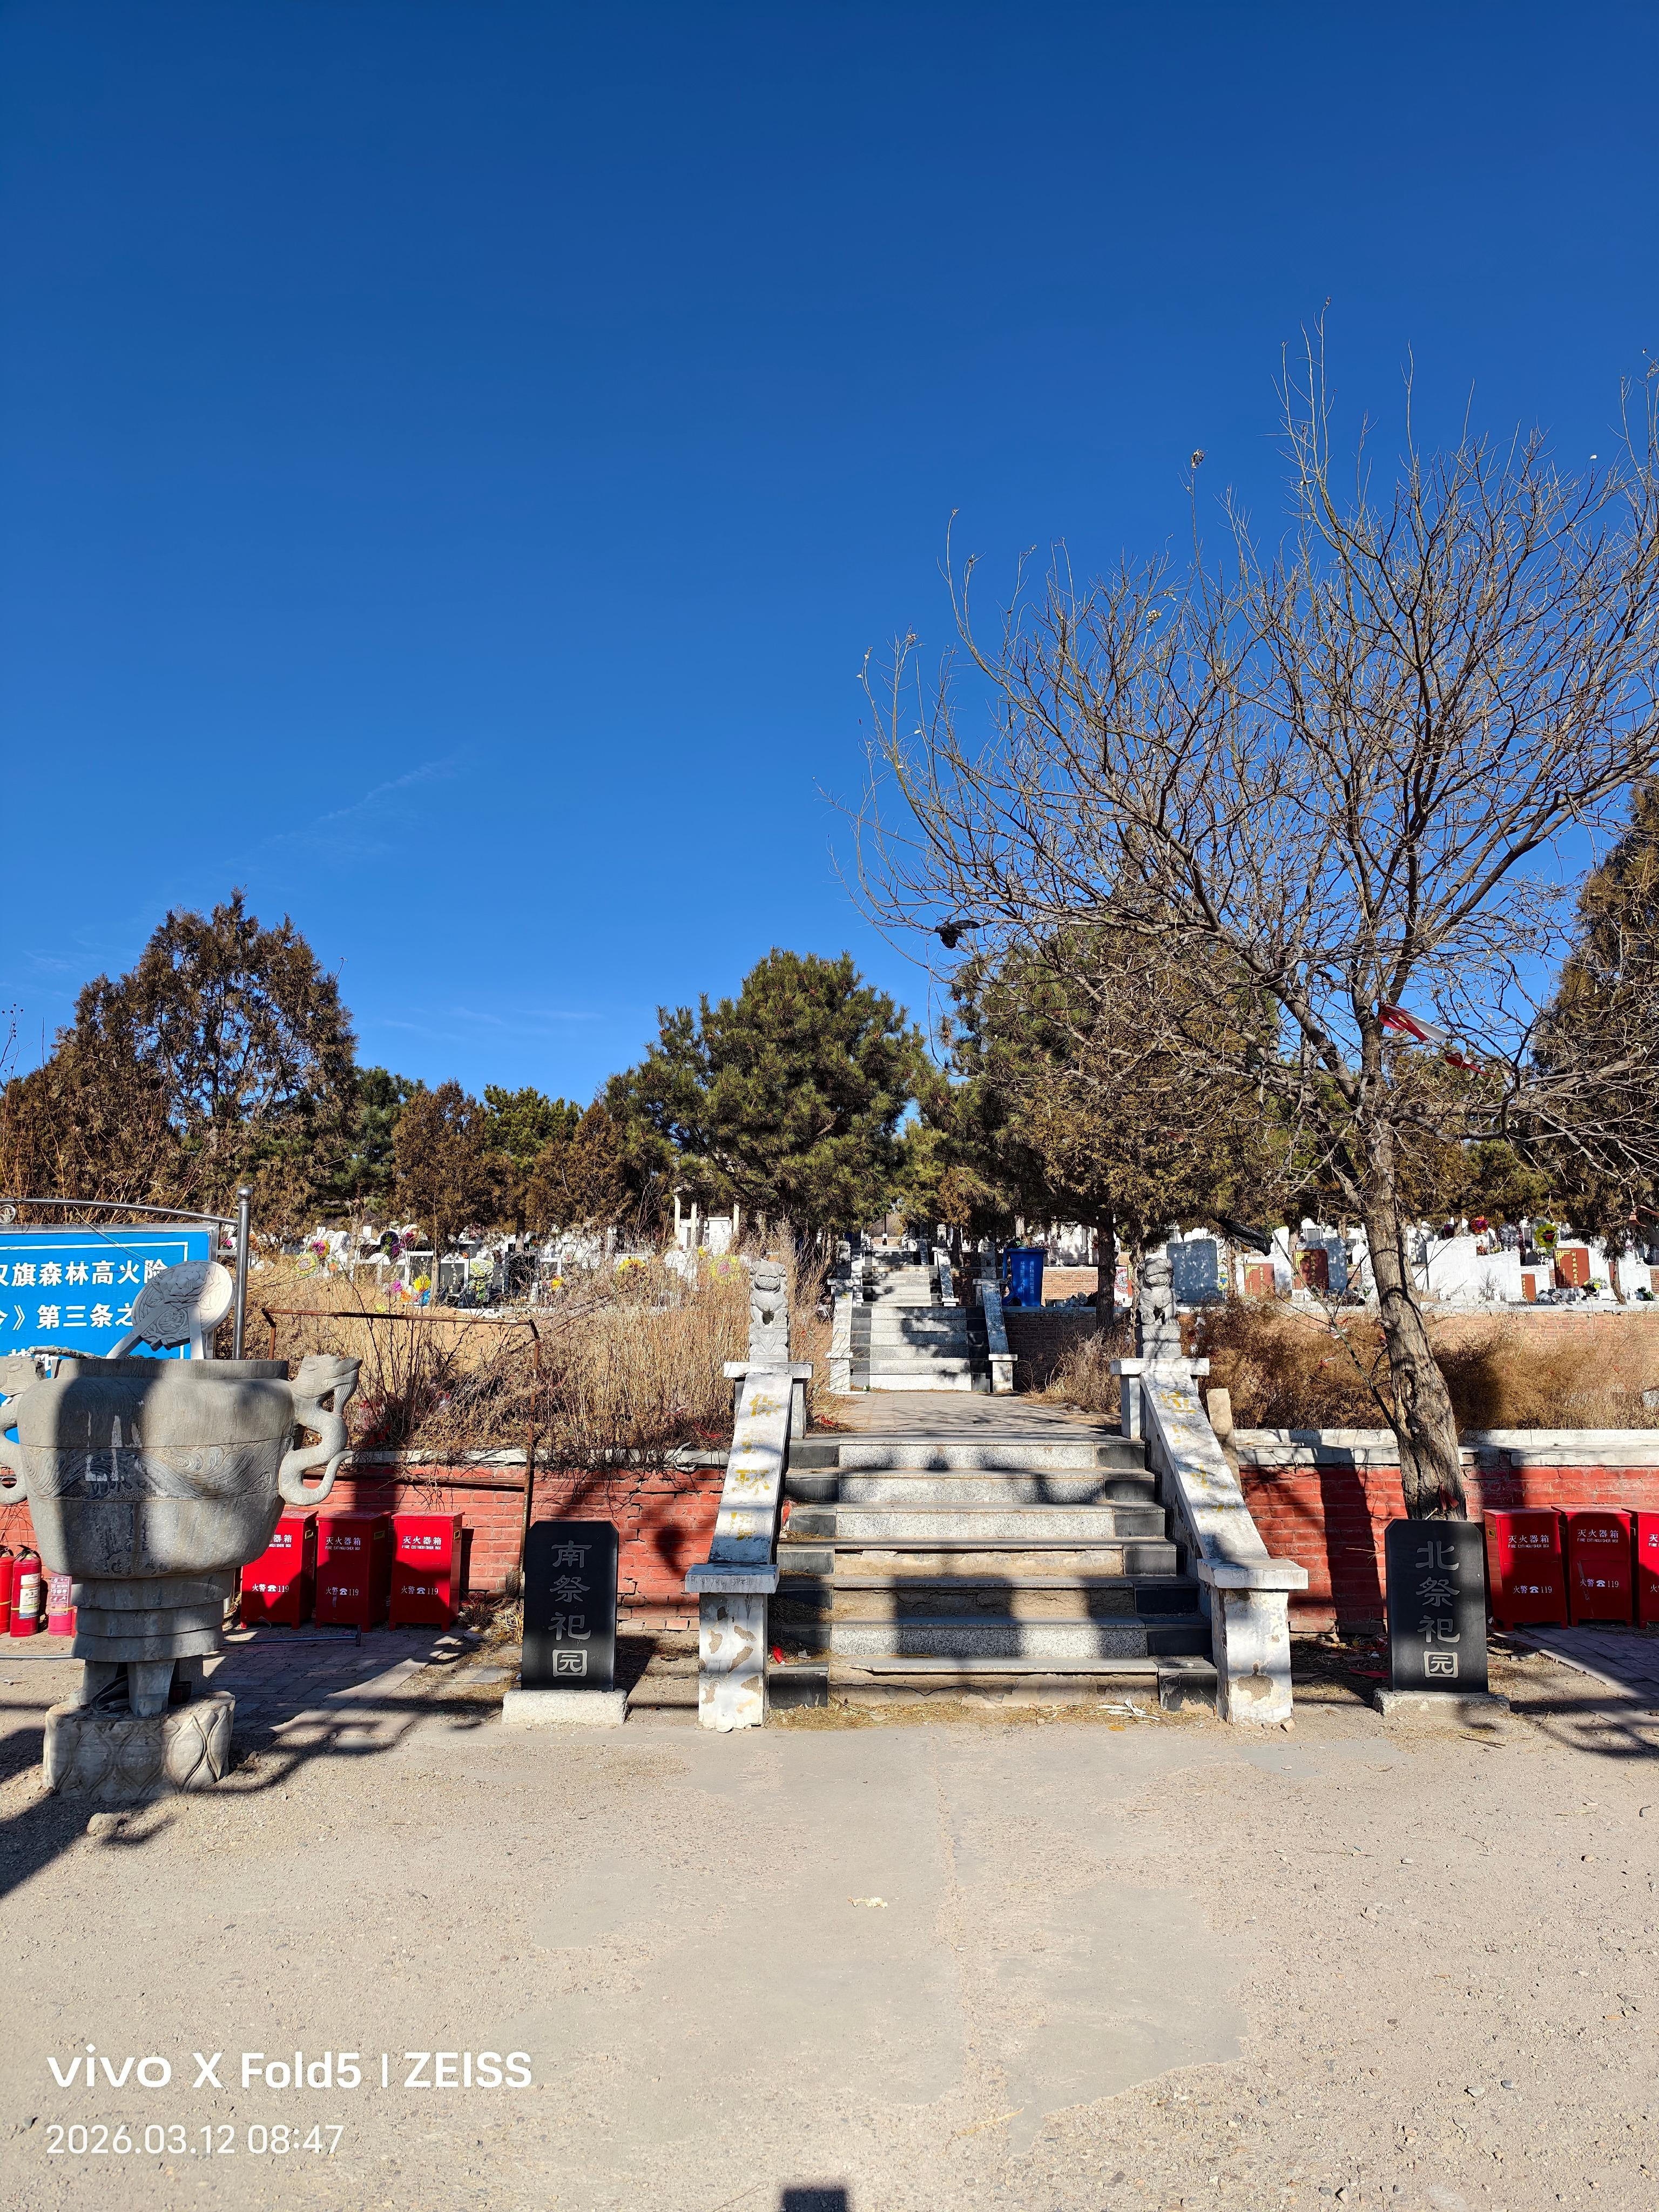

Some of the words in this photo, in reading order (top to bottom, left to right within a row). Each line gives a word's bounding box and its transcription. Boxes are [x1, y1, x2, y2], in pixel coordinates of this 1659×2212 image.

[1577, 1529, 1618, 1538] 灭火器箱
[273, 1534, 292, 1543] 器箱
[326, 1536, 361, 1546] 灭火器箱
[402, 1536, 442, 1545] 灭火器箱
[1508, 1535, 1549, 1543] 灭火器箱
[252, 1583, 266, 1592] 火警
[1580, 1579, 1594, 1587] 火警
[326, 1587, 338, 1595] 火警
[401, 1586, 415, 1594] 火警
[1513, 1586, 1528, 1594] 火警
[548, 1540, 592, 1677] 南祭祀园
[1415, 1540, 1460, 1678] 北祭祀园
